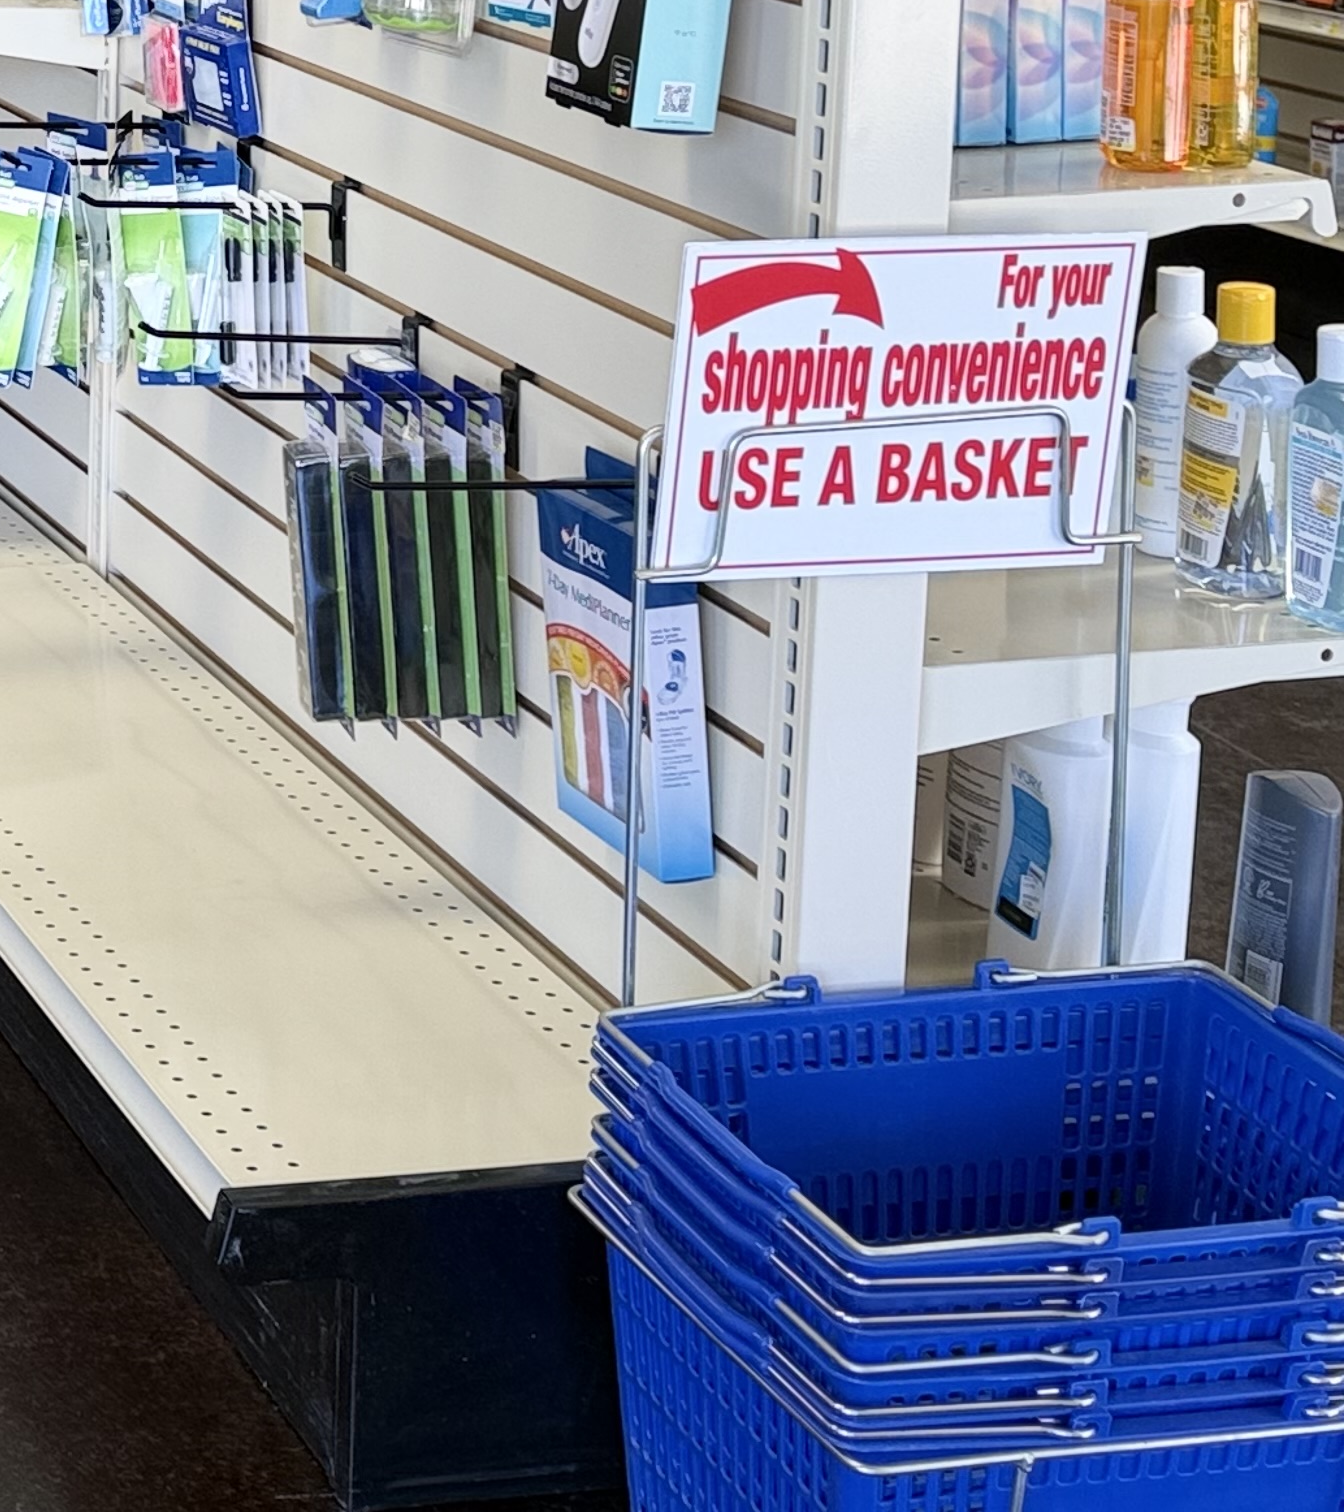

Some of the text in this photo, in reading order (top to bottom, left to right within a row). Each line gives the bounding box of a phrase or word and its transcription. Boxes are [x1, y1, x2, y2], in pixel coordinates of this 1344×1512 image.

[998, 254, 1113, 319] For your
[701, 322, 1107, 426] shopping convenience
[698, 435, 1089, 512] USE A BASKET
[567, 523, 606, 569] Apex
[570, 582, 632, 631] MediPlanner
